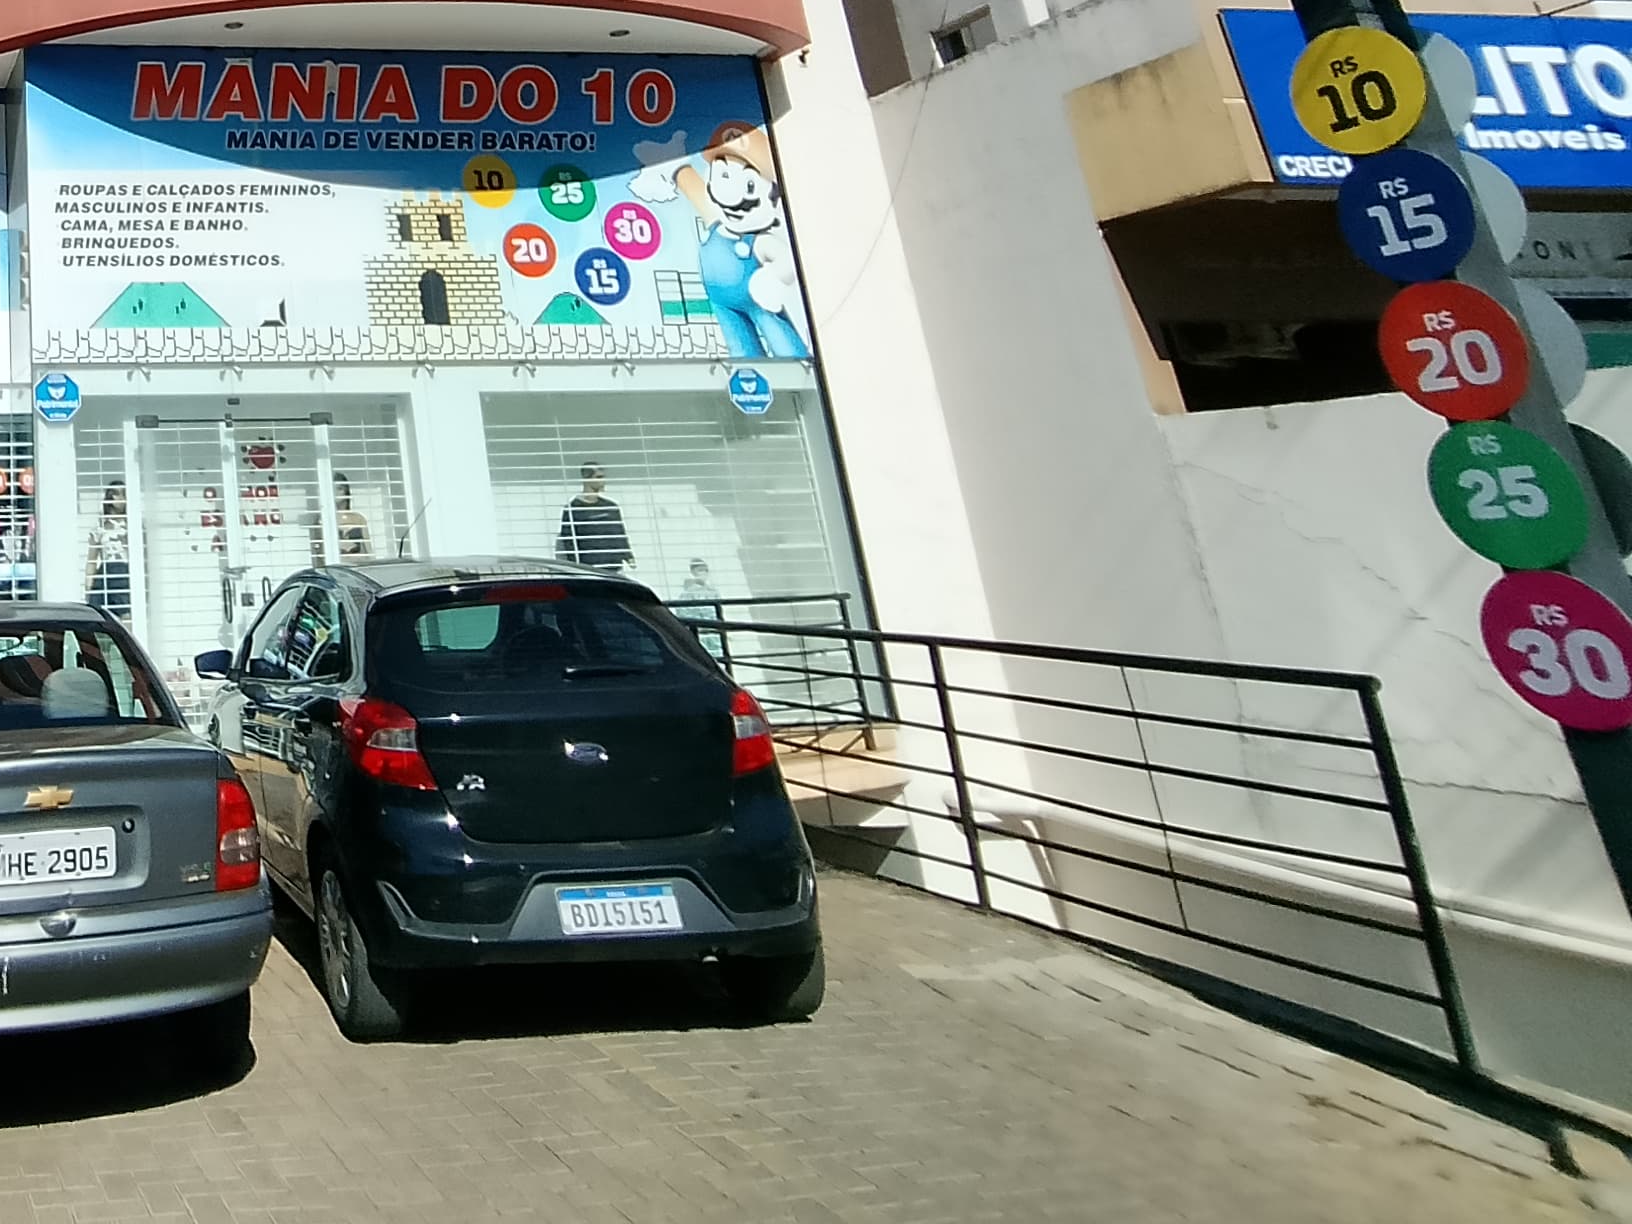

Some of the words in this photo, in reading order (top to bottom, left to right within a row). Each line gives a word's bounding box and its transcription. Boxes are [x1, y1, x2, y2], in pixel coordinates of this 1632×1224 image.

[131, 61, 419, 123] MANIA
[440, 64, 559, 125] DO
[581, 68, 677, 126] 10
[1472, 44, 1632, 117] ITO
[1317, 70, 1396, 133] 10
[226, 130, 316, 150] MANIA
[322, 131, 359, 150] DE
[366, 131, 474, 151] VENDER
[480, 130, 597, 152] BARATO!
[1279, 155, 1353, 177] CRECI
[59, 184, 128, 197] ROUPAS
[132, 185, 143, 197] E
[146, 184, 235, 199] CALÇADOS
[240, 185, 336, 198] FEMININOS,
[474, 170, 504, 191] 10
[550, 182, 584, 205] 25
[55, 202, 168, 214] MASCULINOS
[172, 202, 182, 214] E
[186, 202, 269, 214] INFANTIS.
[60, 219, 113, 233] CAMA,
[118, 219, 165, 231] MESA
[169, 219, 180, 231] E
[184, 219, 248, 231] BANHO.
[613, 218, 652, 245] 30
[1367, 193, 1448, 256] 15
[61, 237, 179, 249] BRINQUEDOS.
[511, 237, 548, 263] 20
[62, 253, 165, 266] UTENSÍLIOS
[169, 253, 285, 266] DOMÉSTICOS.
[585, 268, 620, 295] 15
[1406, 329, 1502, 392] 20
[1458, 465, 1549, 519] 25
[1507, 628, 1631, 700] 30
[48, 846, 109, 875] 2905
